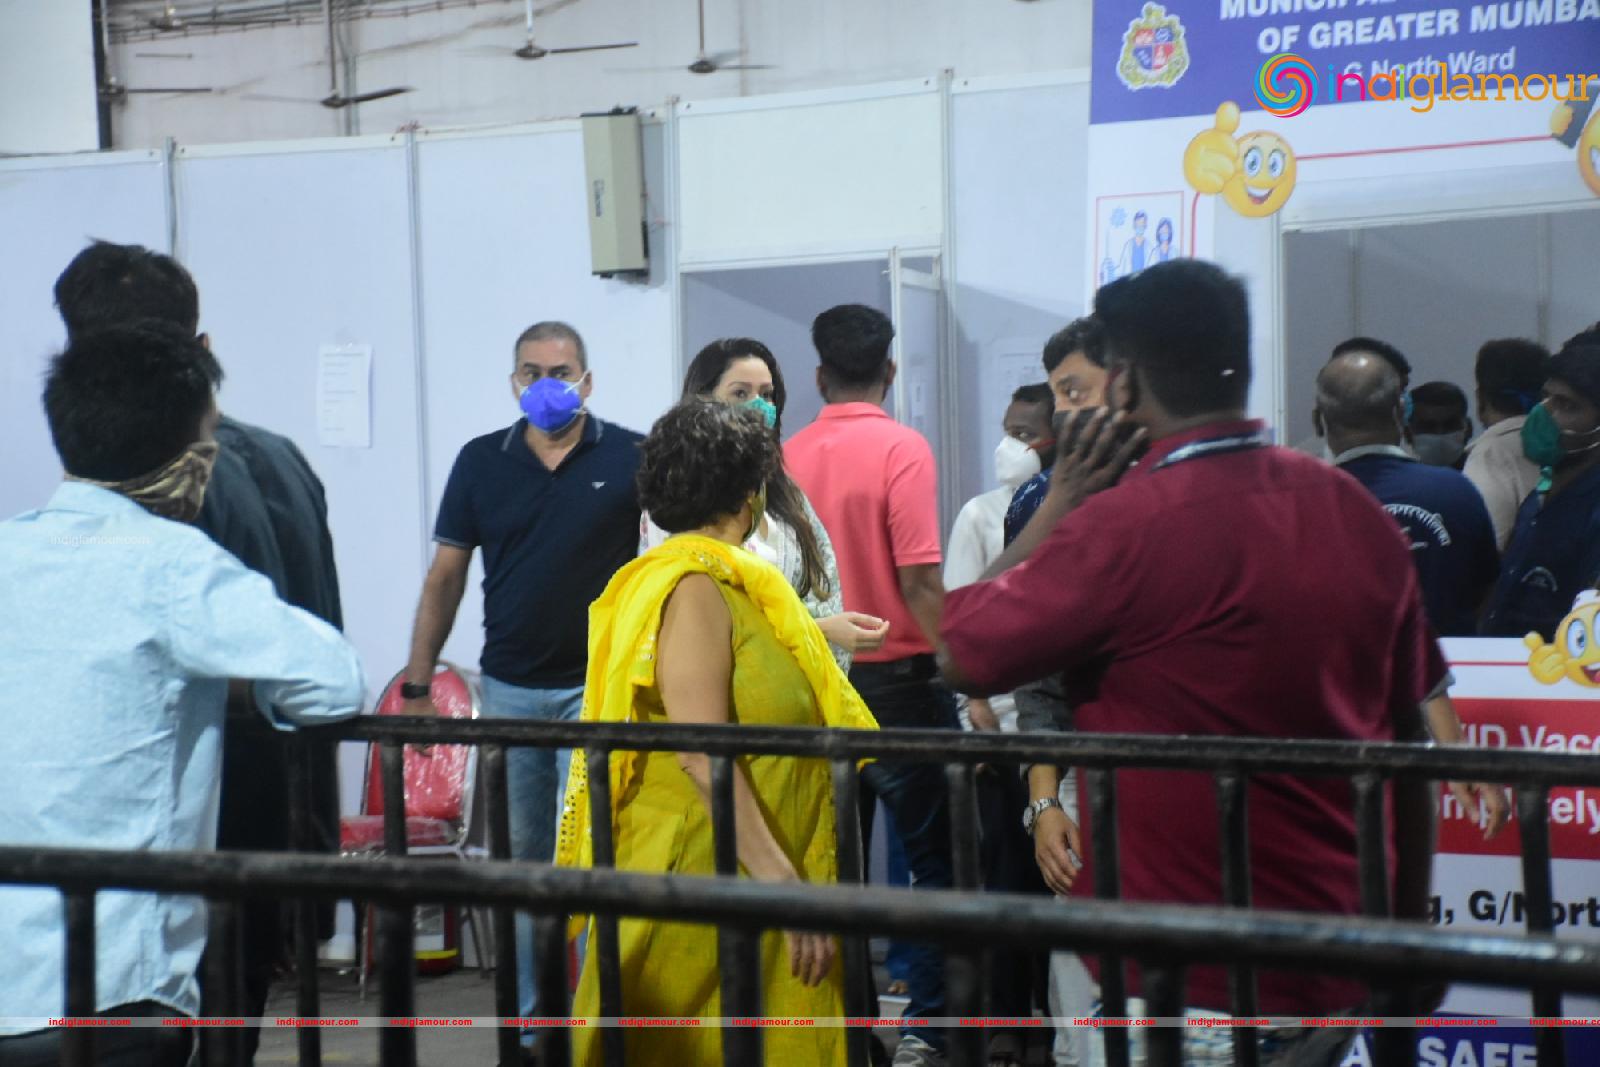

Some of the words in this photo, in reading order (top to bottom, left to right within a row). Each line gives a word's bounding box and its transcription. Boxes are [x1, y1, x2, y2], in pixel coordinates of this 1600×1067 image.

[1257, 25, 1300, 54] OF
[1308, 8, 1460, 50] GREATER
[1448, 46, 1516, 74] Ward
